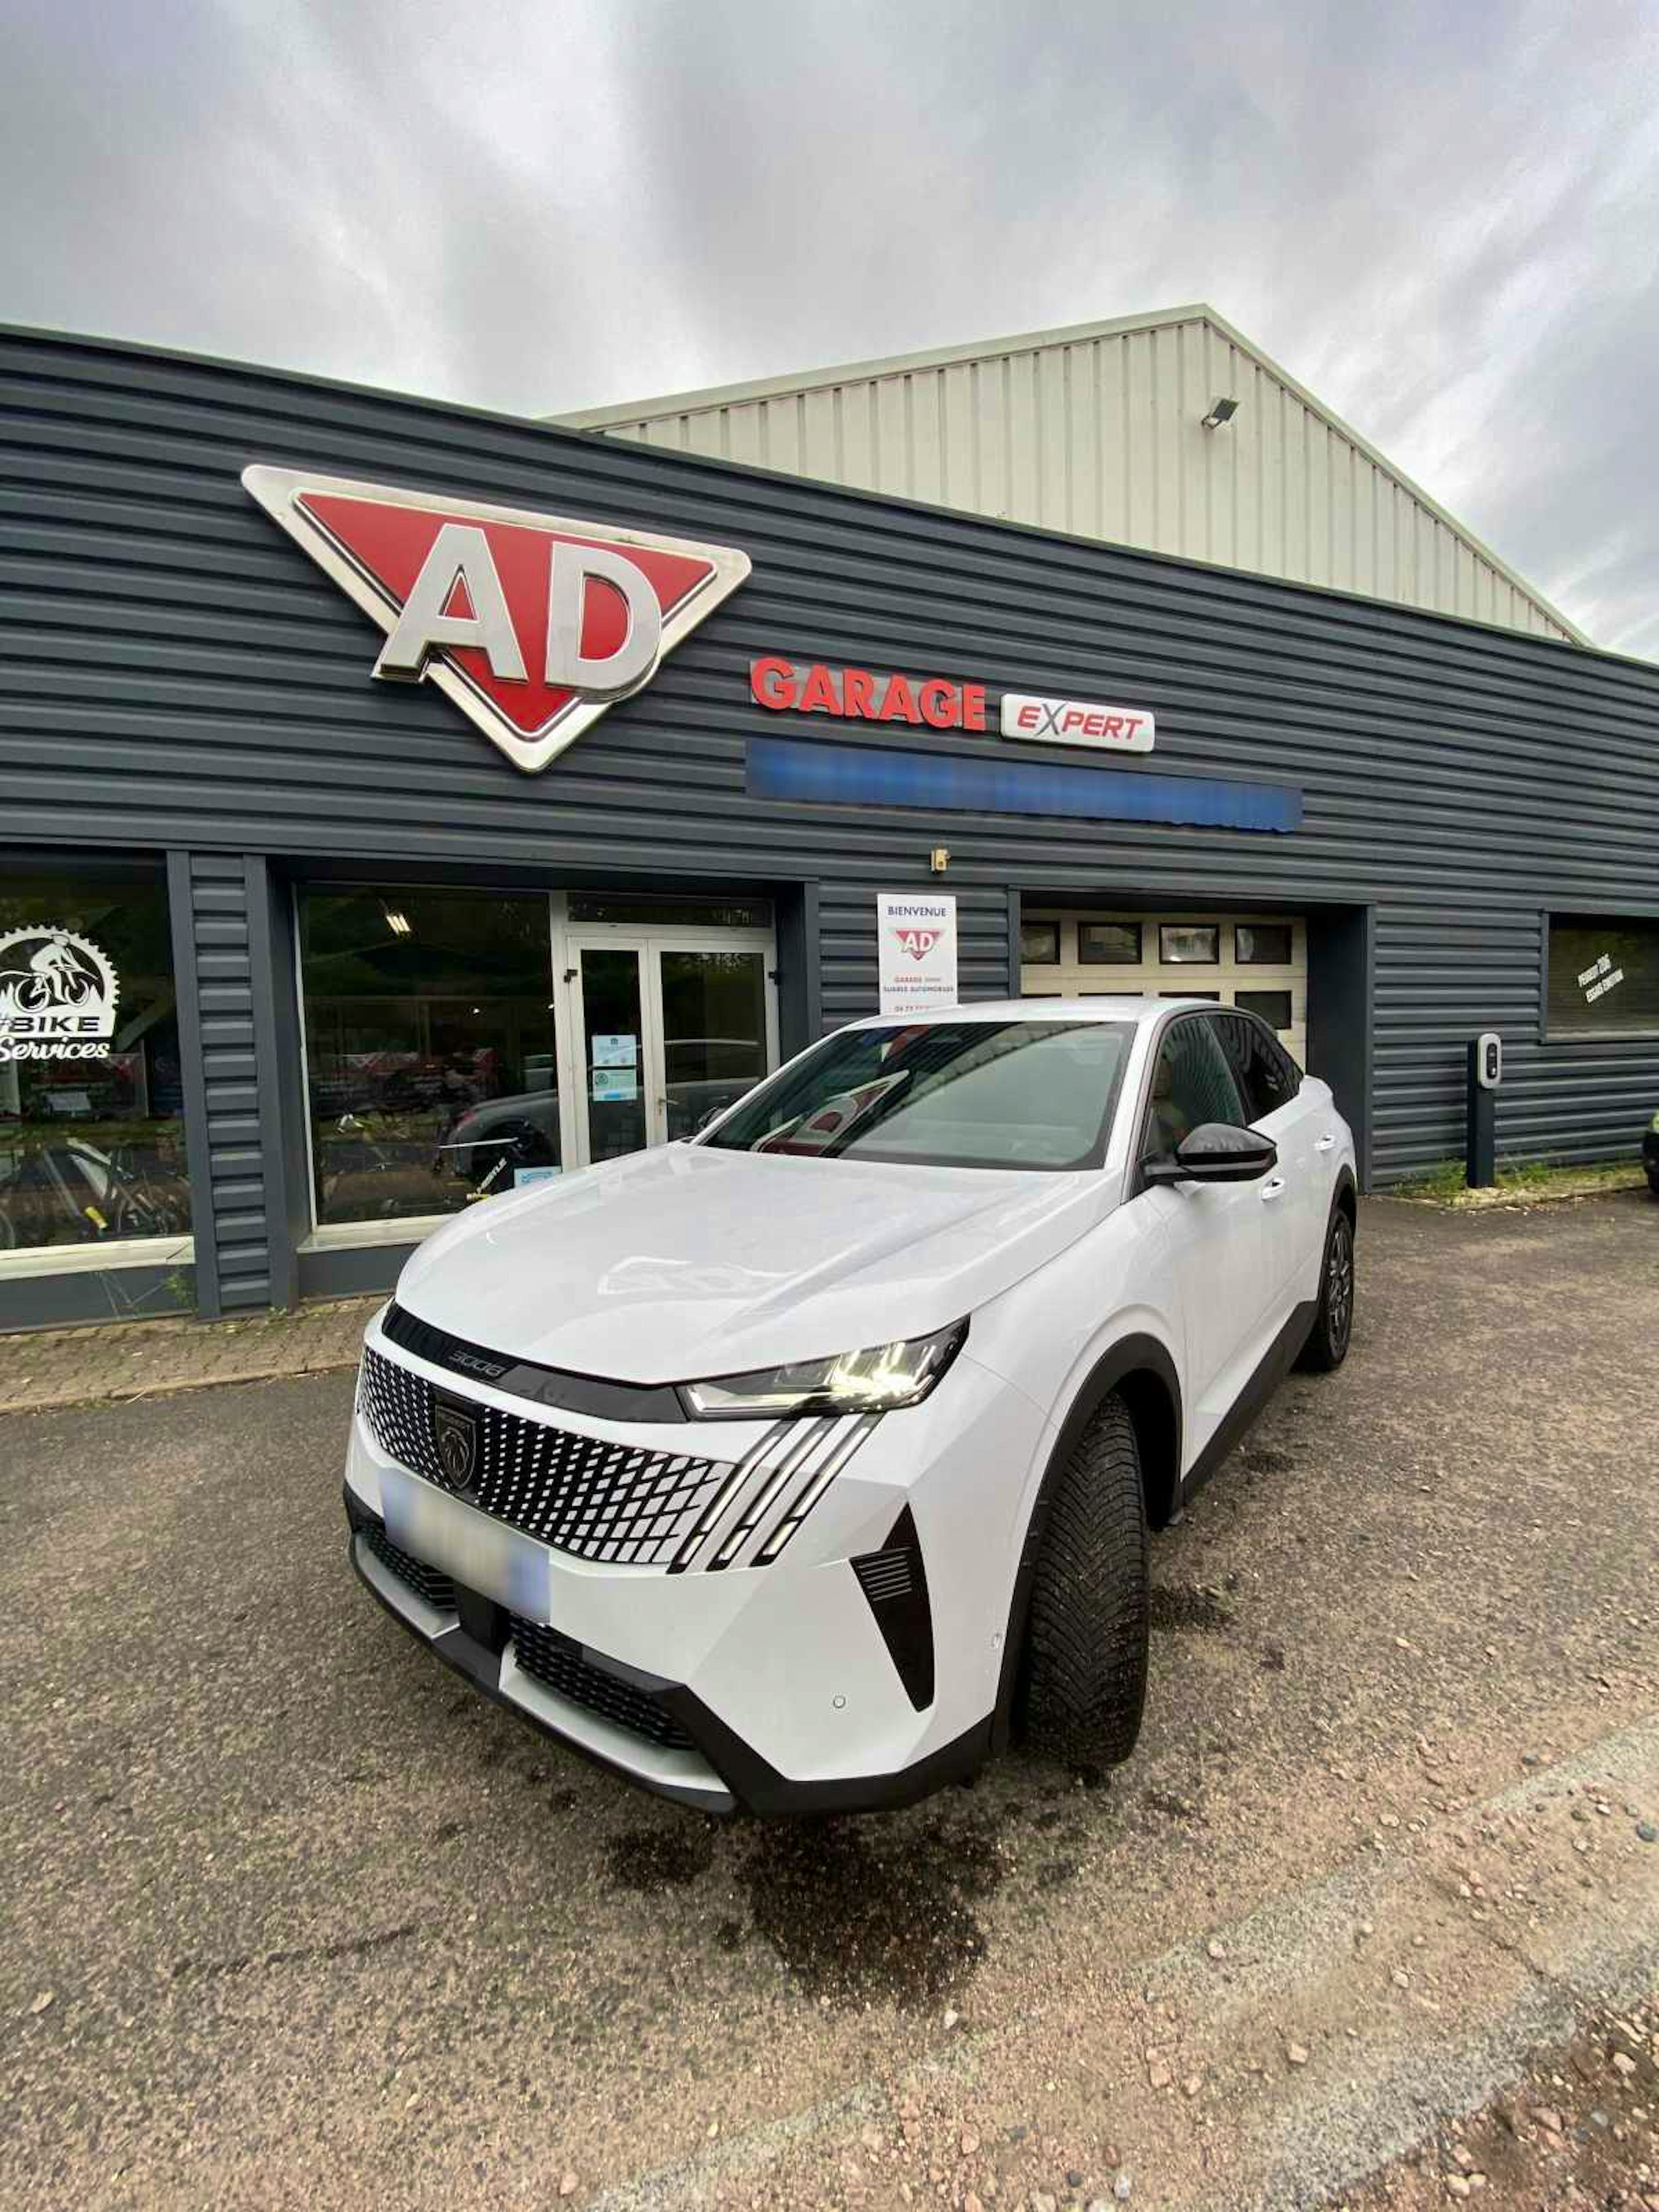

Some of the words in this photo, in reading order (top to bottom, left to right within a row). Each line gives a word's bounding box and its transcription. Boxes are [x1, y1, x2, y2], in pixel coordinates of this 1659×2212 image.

[371, 522, 663, 702] AD
[750, 657, 987, 731] GARAGE
[888, 906, 947, 916] BIENVENUE
[901, 931, 934, 952] AD
[0, 1036, 110, 1062] Services
[448, 1350, 507, 1376] 3008
